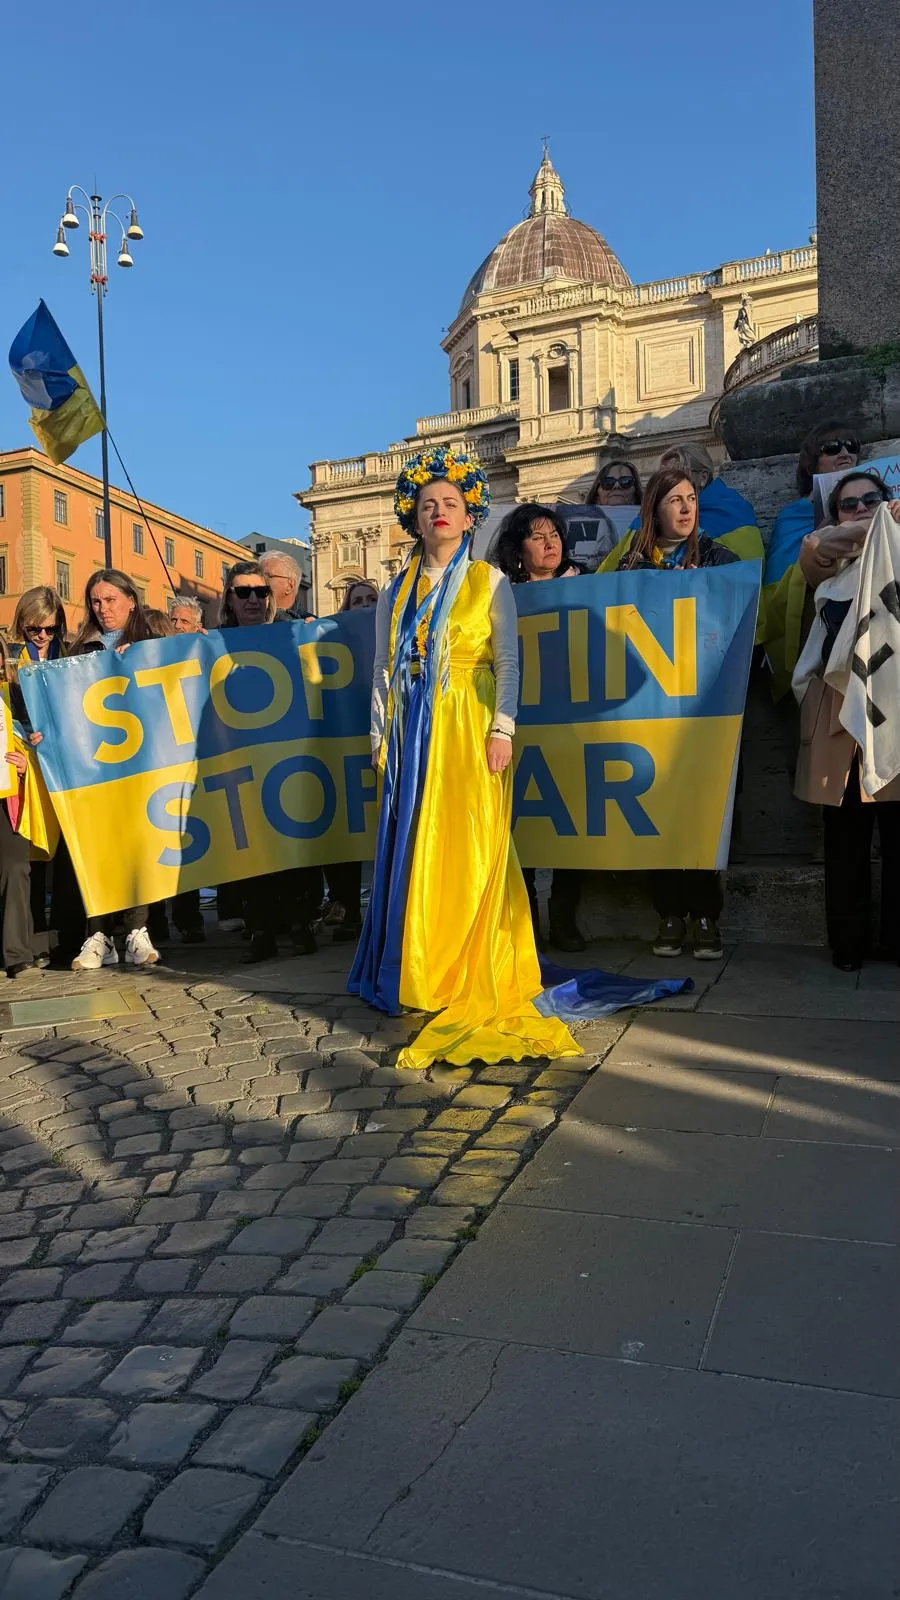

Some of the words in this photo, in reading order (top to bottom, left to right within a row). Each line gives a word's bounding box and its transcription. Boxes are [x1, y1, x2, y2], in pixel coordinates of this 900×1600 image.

[82, 642, 354, 763] STOP
[518, 597, 697, 706] TIN
[147, 755, 378, 867] STOP
[511, 742, 660, 837] AR
